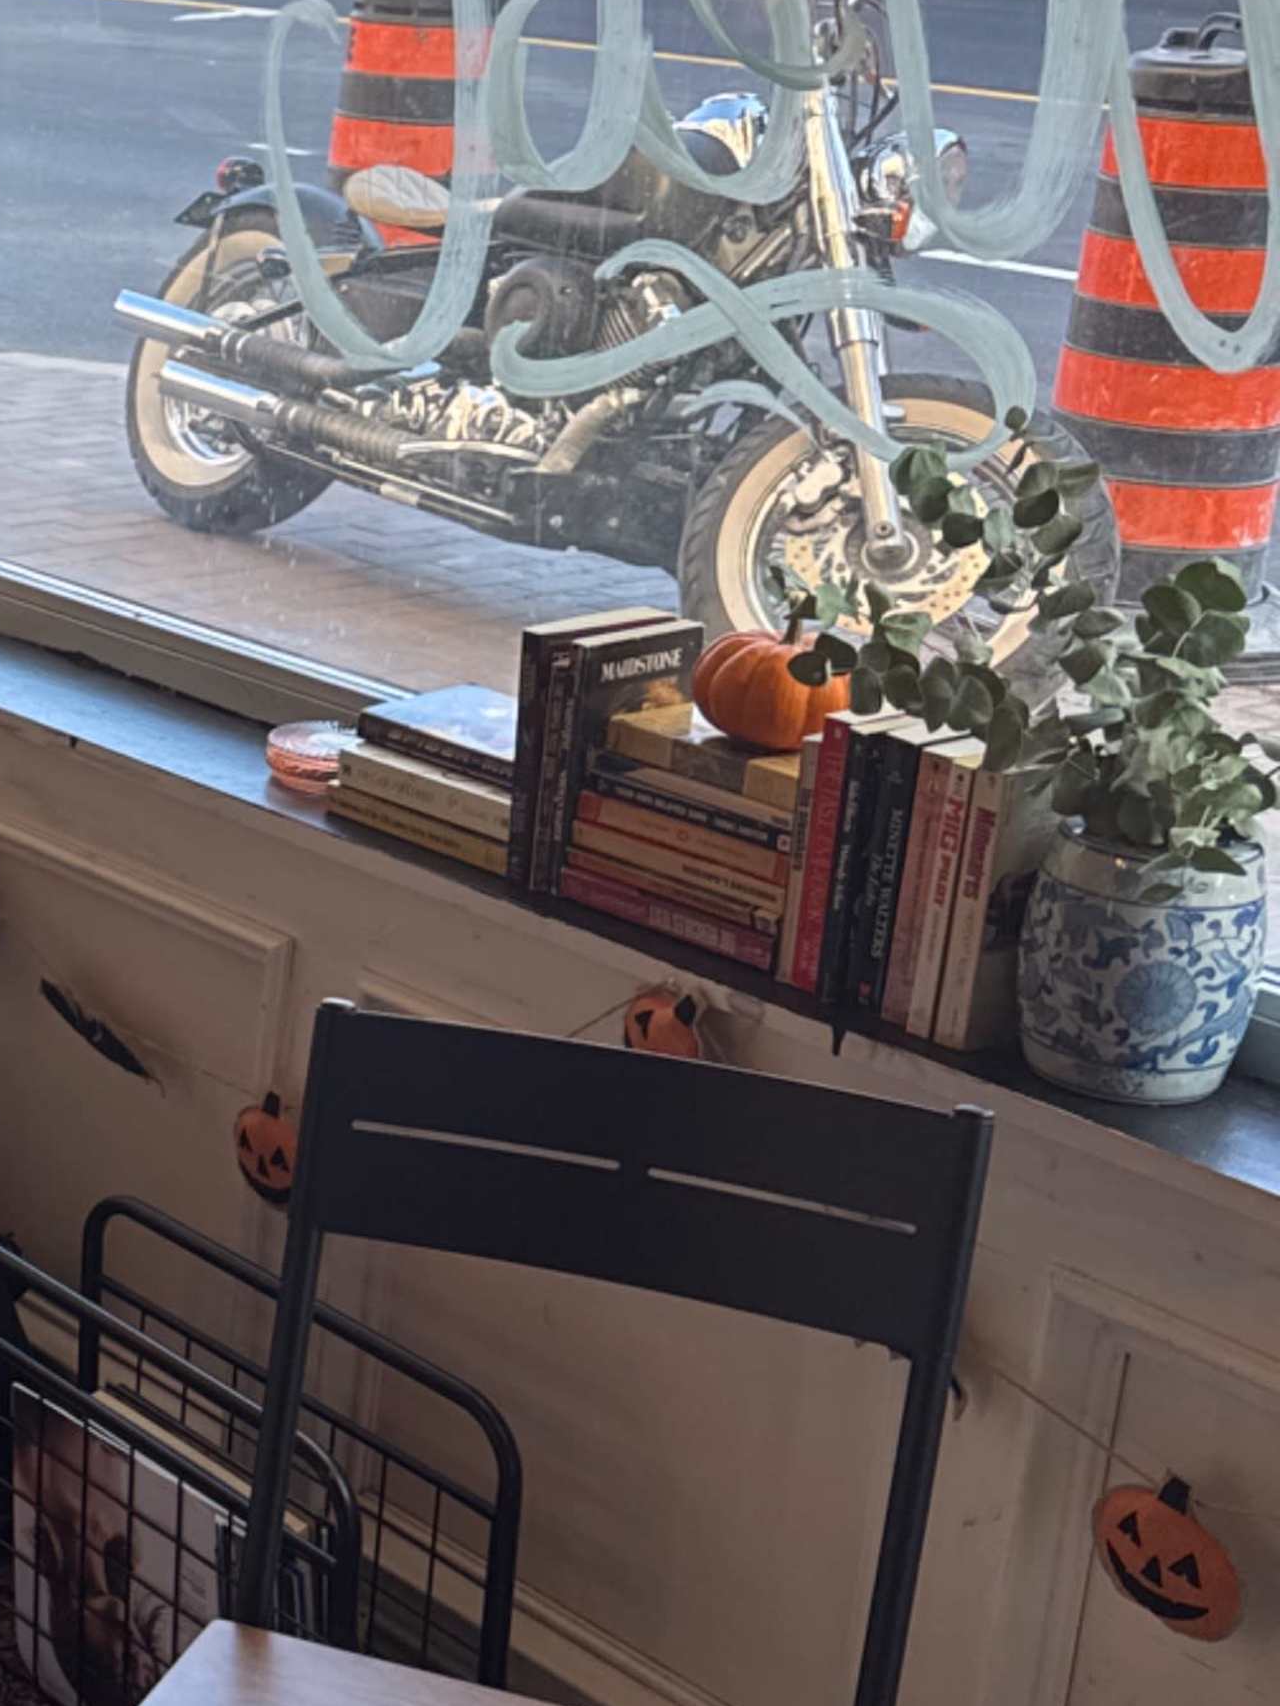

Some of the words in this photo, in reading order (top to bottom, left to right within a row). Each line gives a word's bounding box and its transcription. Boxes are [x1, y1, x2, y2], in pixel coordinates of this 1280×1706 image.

[600, 648, 683, 683] MAIDSTONE
[880, 808, 904, 880] MINETTE
[934, 855, 953, 907] PILOT
[870, 886, 893, 959] WALTERS
